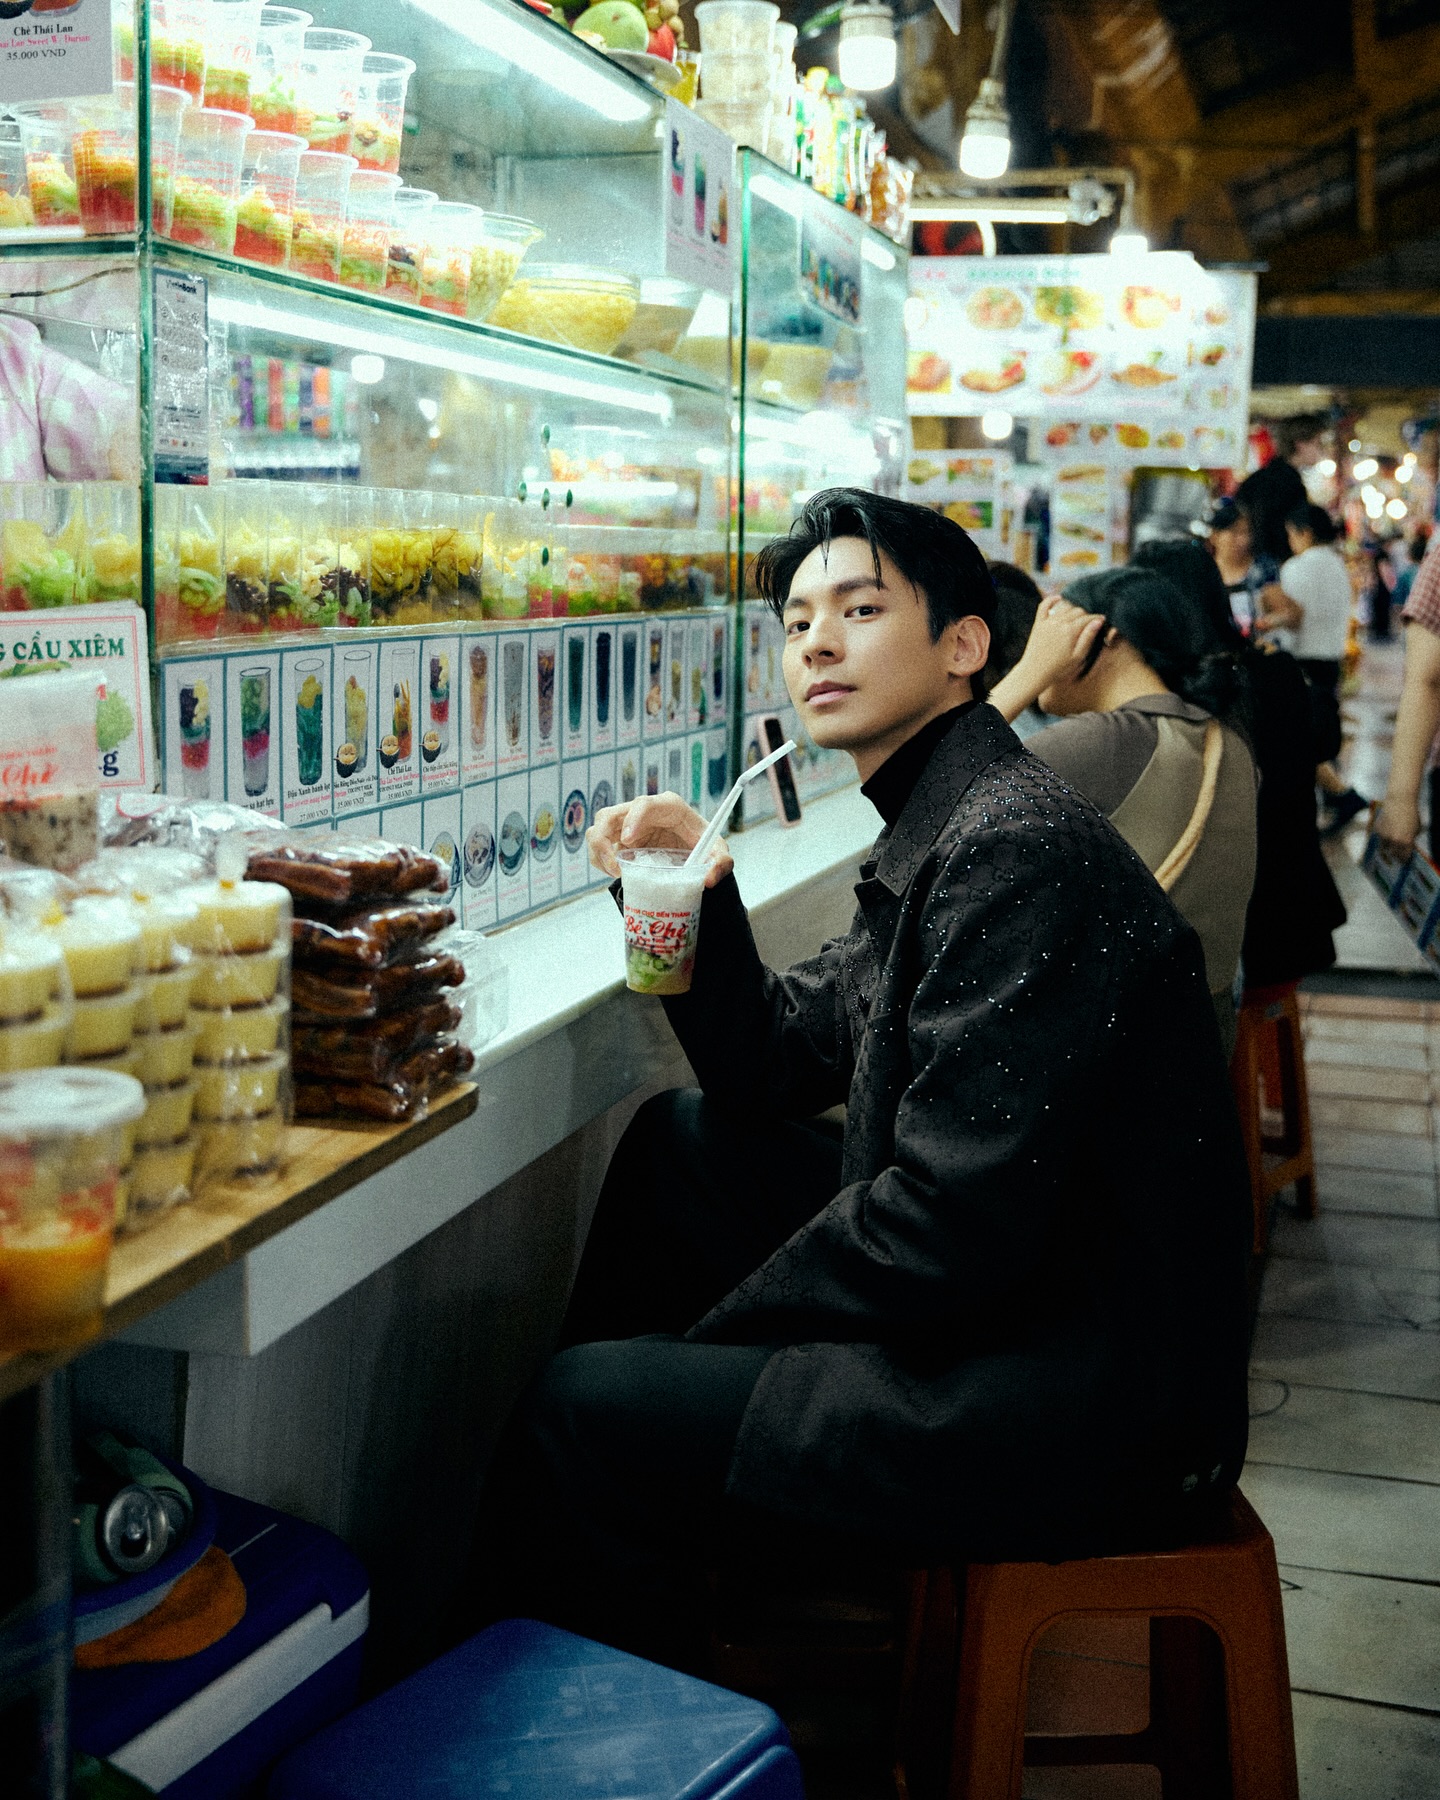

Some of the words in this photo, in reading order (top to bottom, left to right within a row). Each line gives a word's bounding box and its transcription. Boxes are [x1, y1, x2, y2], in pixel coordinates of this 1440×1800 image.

[13, 26, 31, 36] Chè
[33, 25, 54, 35] Thái
[56, 24, 73, 33] Lan
[7, 51, 38, 60] 35.000
[41, 48, 67, 58] VND
[12, 631, 61, 661] CẦU
[68, 633, 125, 658] XIÊM
[99, 751, 119, 777] g
[299, 787, 310, 796] Xanh
